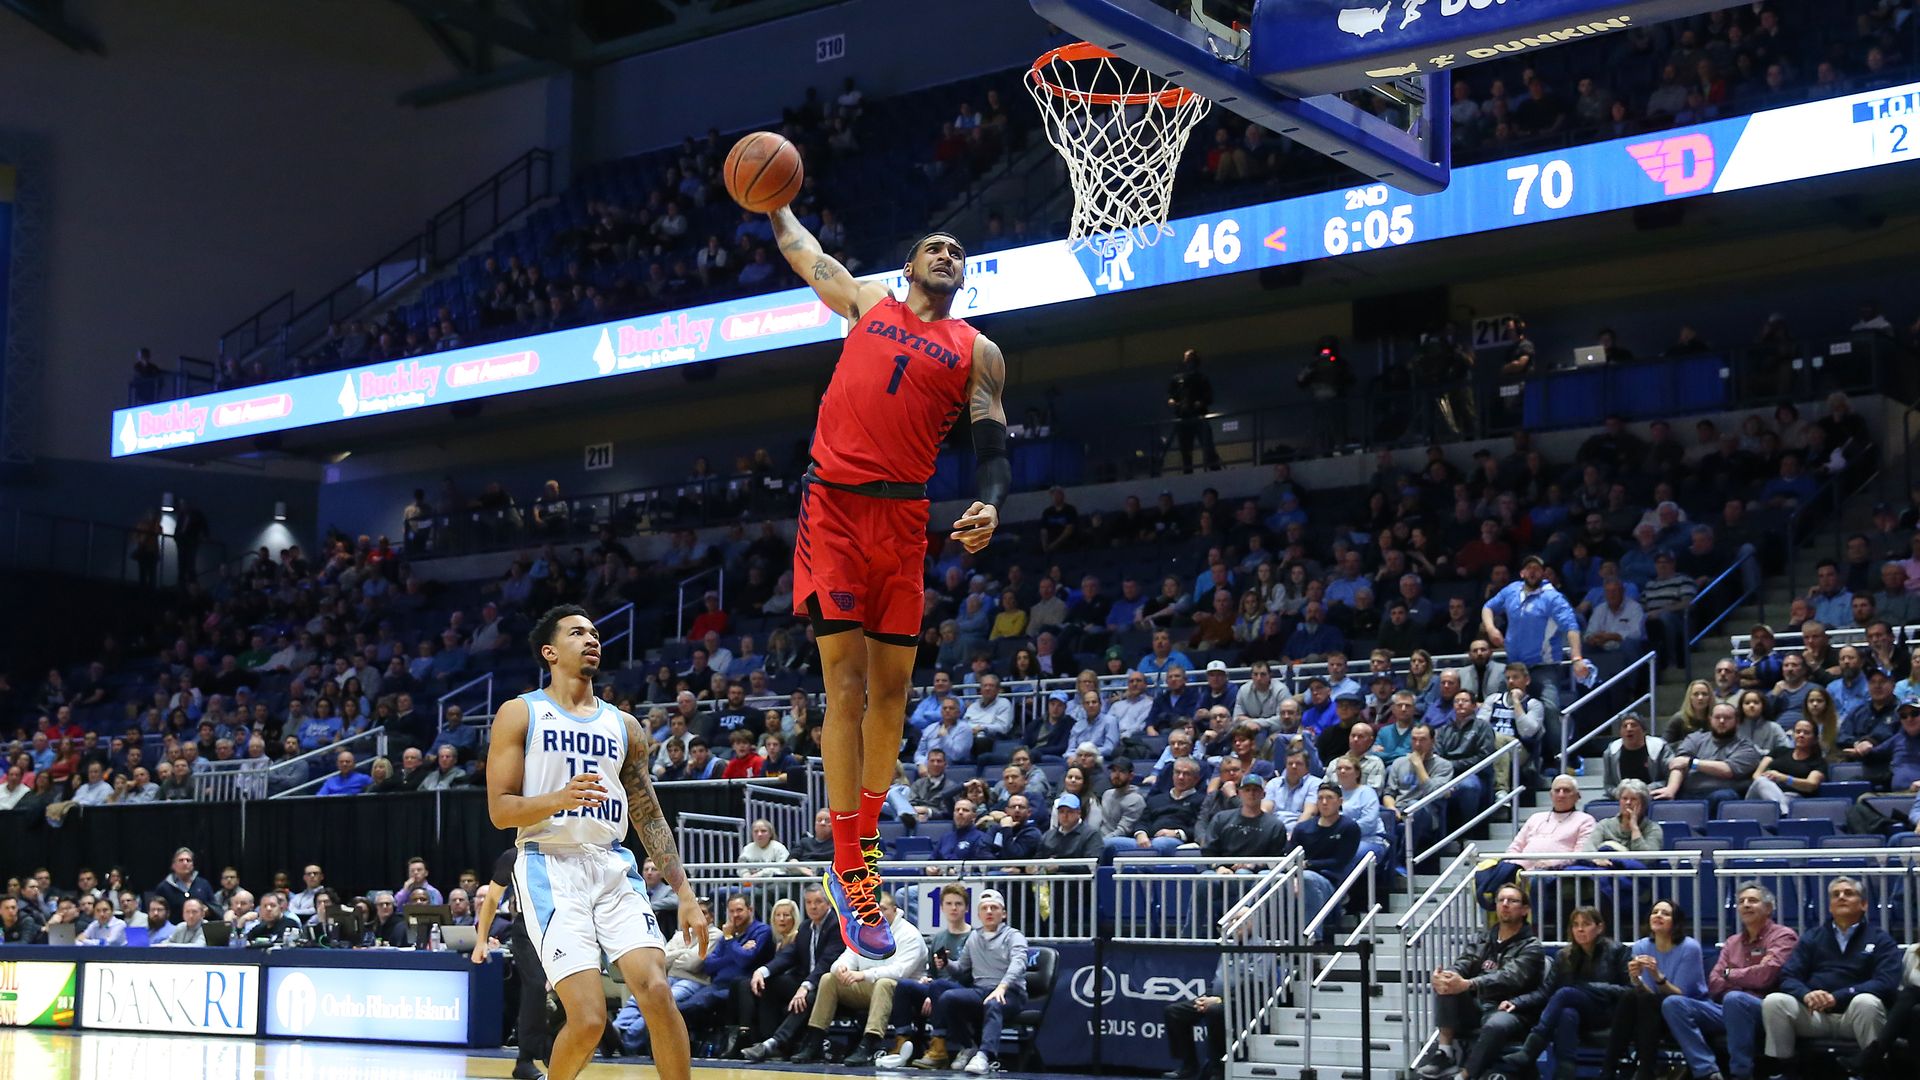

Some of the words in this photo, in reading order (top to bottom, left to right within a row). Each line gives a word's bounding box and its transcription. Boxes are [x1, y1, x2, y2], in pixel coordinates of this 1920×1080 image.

[818, 38, 842, 59] 310
[1890, 124, 1908, 153] 2
[1344, 185, 1388, 210] 2ND
[1507, 160, 1574, 216] 70
[1183, 219, 1241, 268] 46
[1323, 205, 1413, 255] 6:05
[967, 287, 978, 309] 2
[617, 313, 714, 356] Buckley
[866, 320, 960, 369] DAYTON
[360, 361, 441, 398] Buckley
[886, 355, 910, 395] 1
[138, 402, 208, 436] Buckley
[588, 446, 609, 467] 211
[543, 730, 617, 761] RHODE
[927, 886, 972, 927] 11
[1120, 973, 1206, 1001] LEX
[321, 993, 365, 1017] Ortho
[365, 995, 414, 1019] Rhode
[415, 996, 460, 1021] Island
[1141, 1022, 1165, 1039] OF
